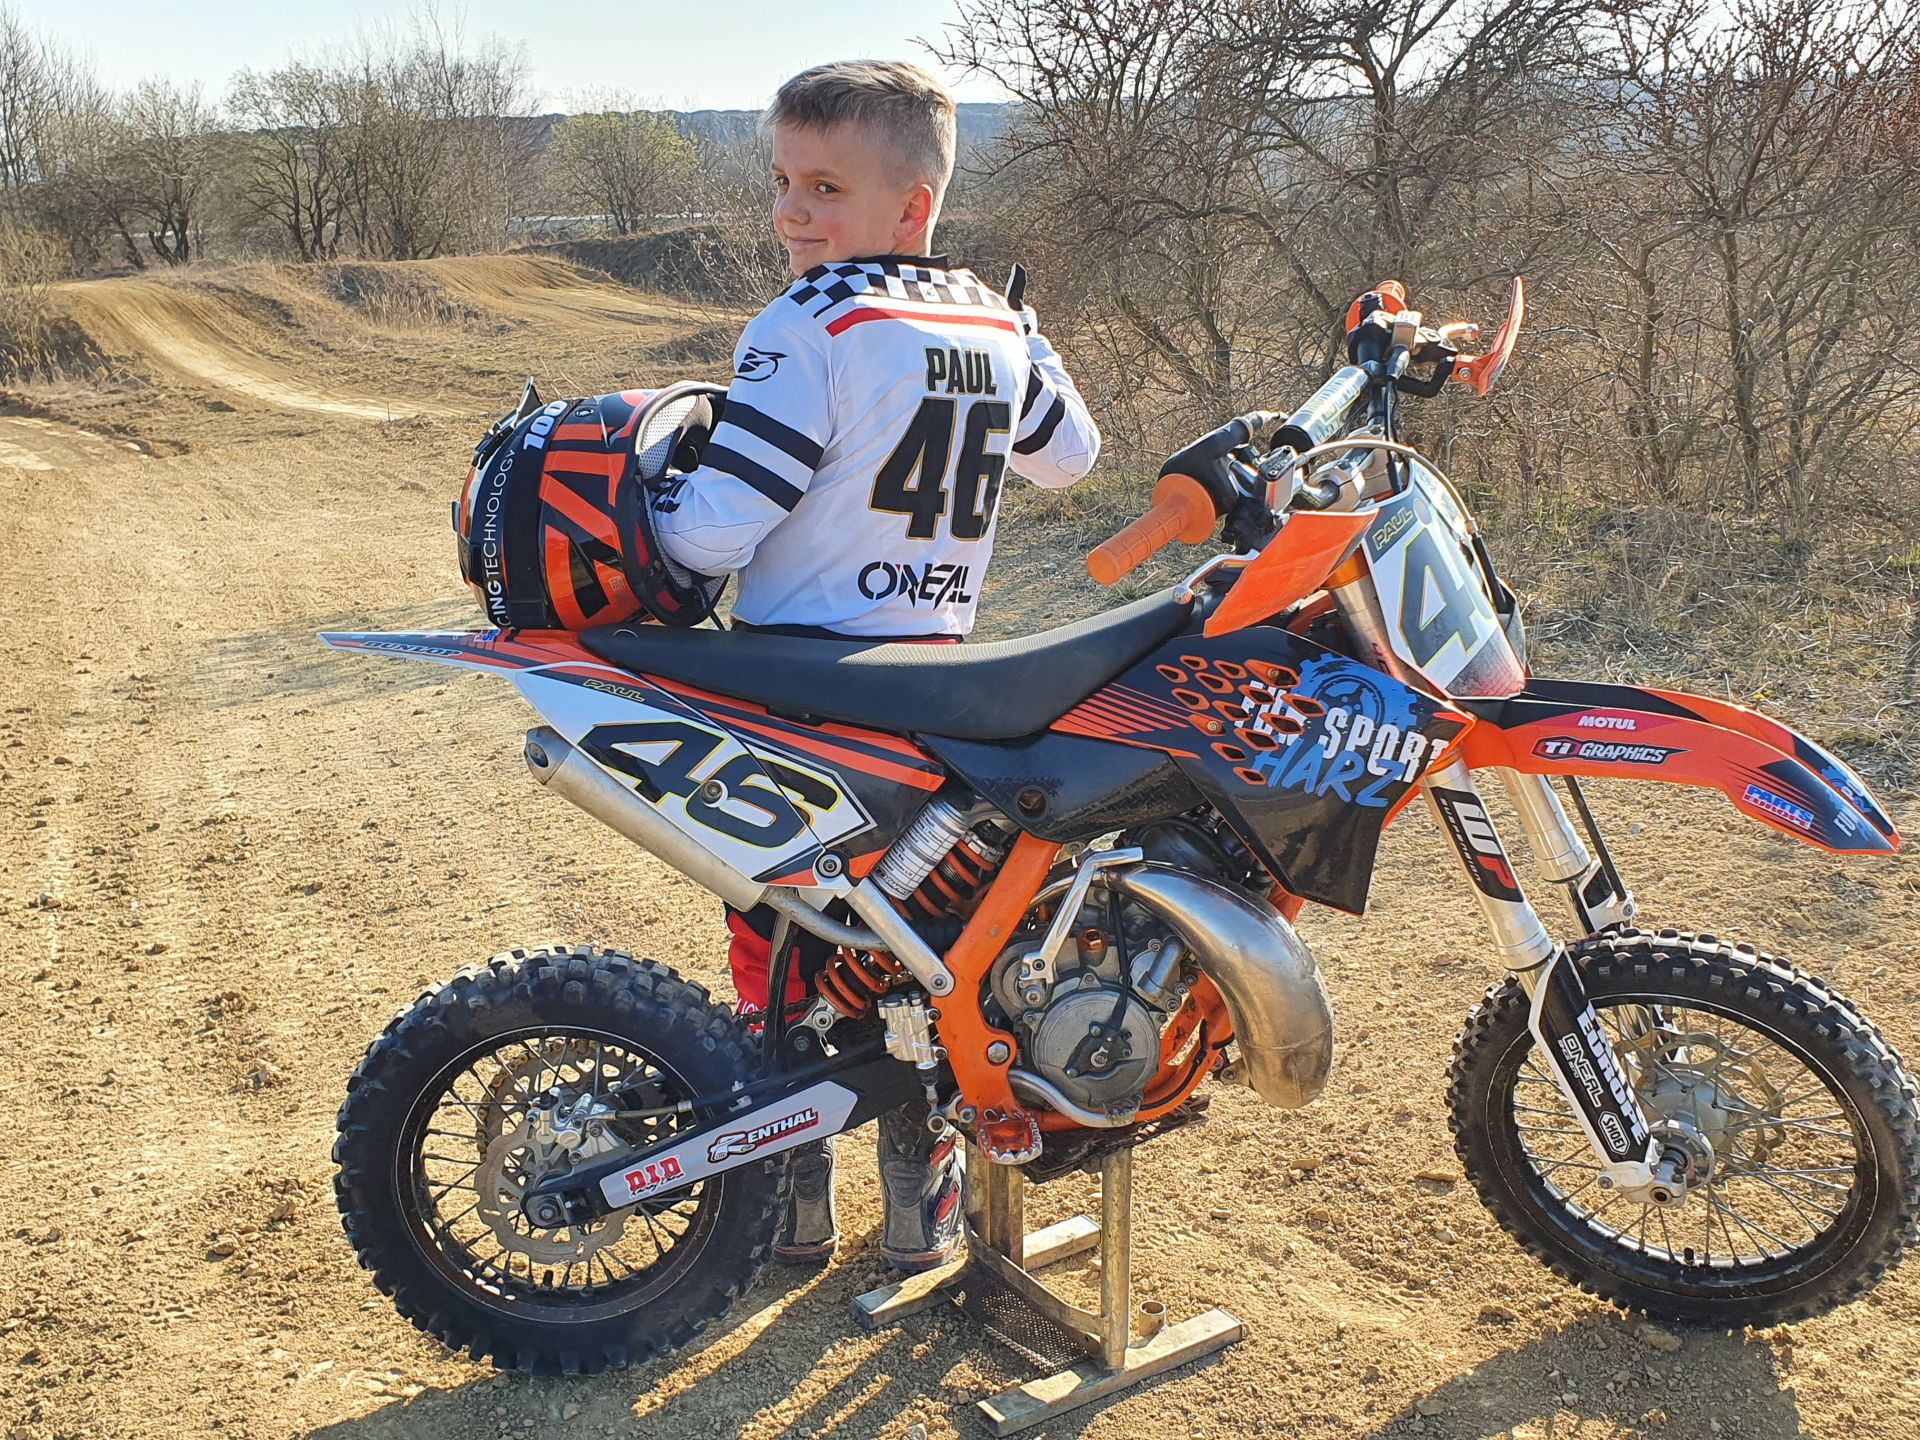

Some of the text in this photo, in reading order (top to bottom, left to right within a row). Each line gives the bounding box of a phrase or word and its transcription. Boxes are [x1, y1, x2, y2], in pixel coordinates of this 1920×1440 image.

[923, 346, 997, 396] PAUL
[523, 400, 568, 450] 100
[868, 397, 1011, 542] 46
[1372, 507, 1413, 551] PAUL
[1398, 525, 1485, 670] 4
[361, 640, 463, 657] DUNLOP
[583, 679, 645, 702] PAUL
[1578, 716, 1636, 730] MOTUL
[578, 721, 841, 850] 46
[1251, 737, 1406, 807] HARZ
[1744, 795, 1809, 827] EUROPE
[1746, 785, 1812, 823] PARTS
[1576, 1010, 1646, 1146] EUROPE
[710, 1110, 817, 1161] RENTHAL
[1603, 1117, 1626, 1149] SHOEI
